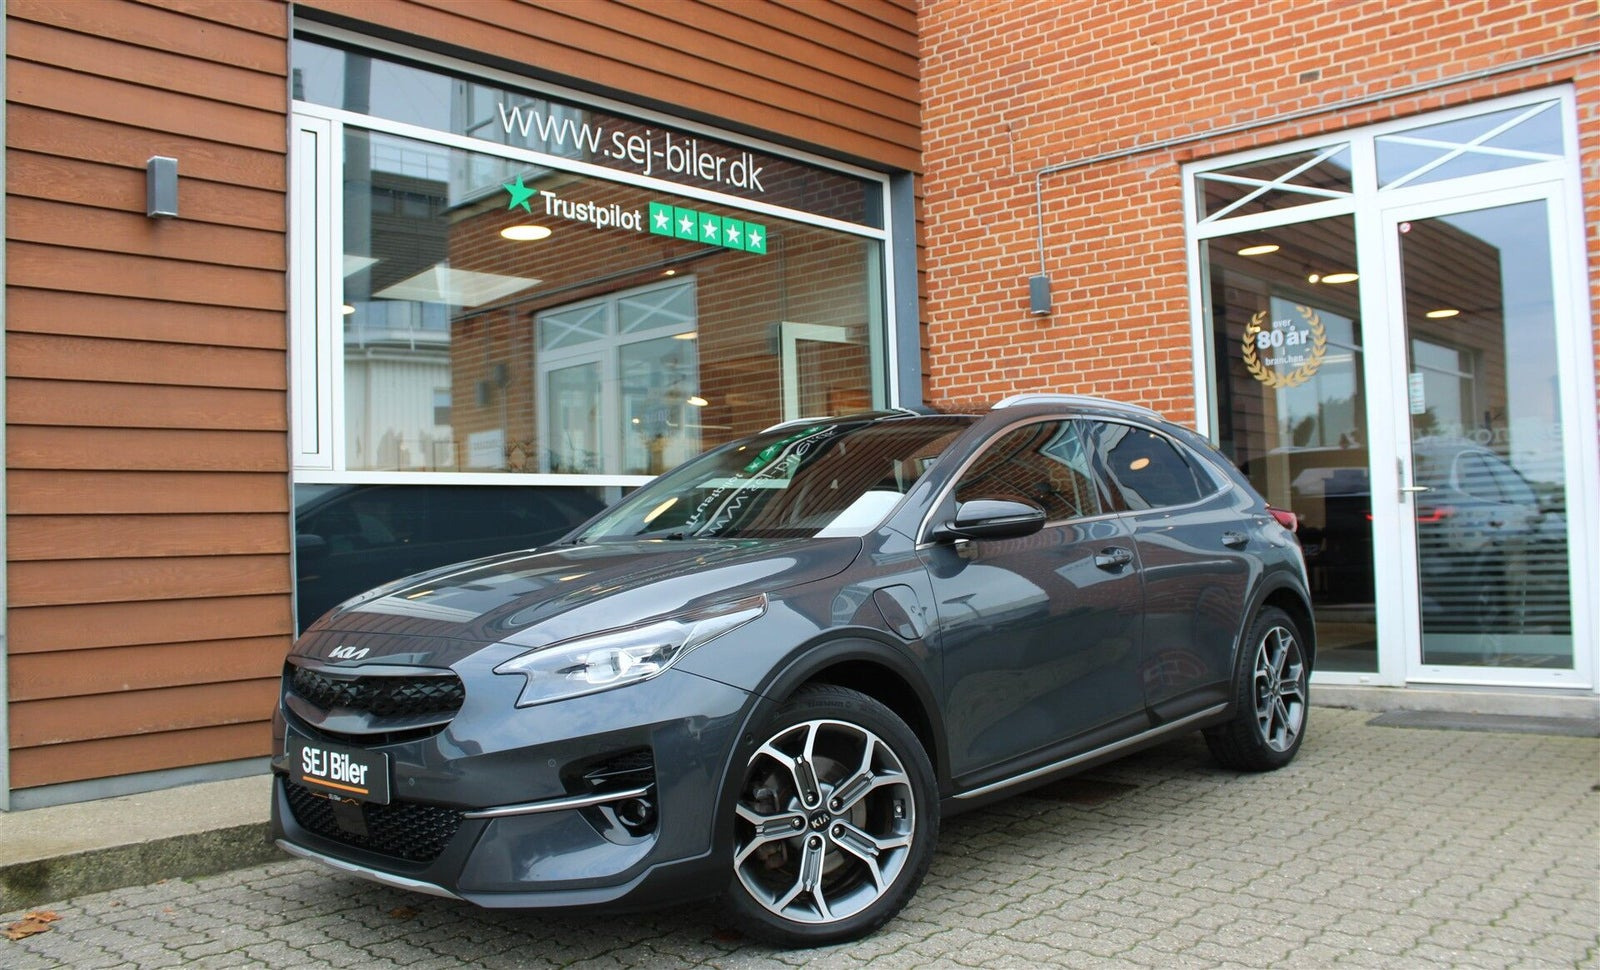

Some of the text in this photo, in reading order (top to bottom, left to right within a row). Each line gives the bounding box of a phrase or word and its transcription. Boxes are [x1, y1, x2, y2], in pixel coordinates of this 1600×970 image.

[499, 102, 764, 192] www.sej-biler.dk
[540, 190, 642, 231] Trustpilot
[1273, 319, 1291, 328] over
[1257, 325, 1309, 349] 80 år
[328, 645, 370, 660] KIA
[302, 746, 368, 785] SEJ Biler
[811, 814, 830, 828] KIA
